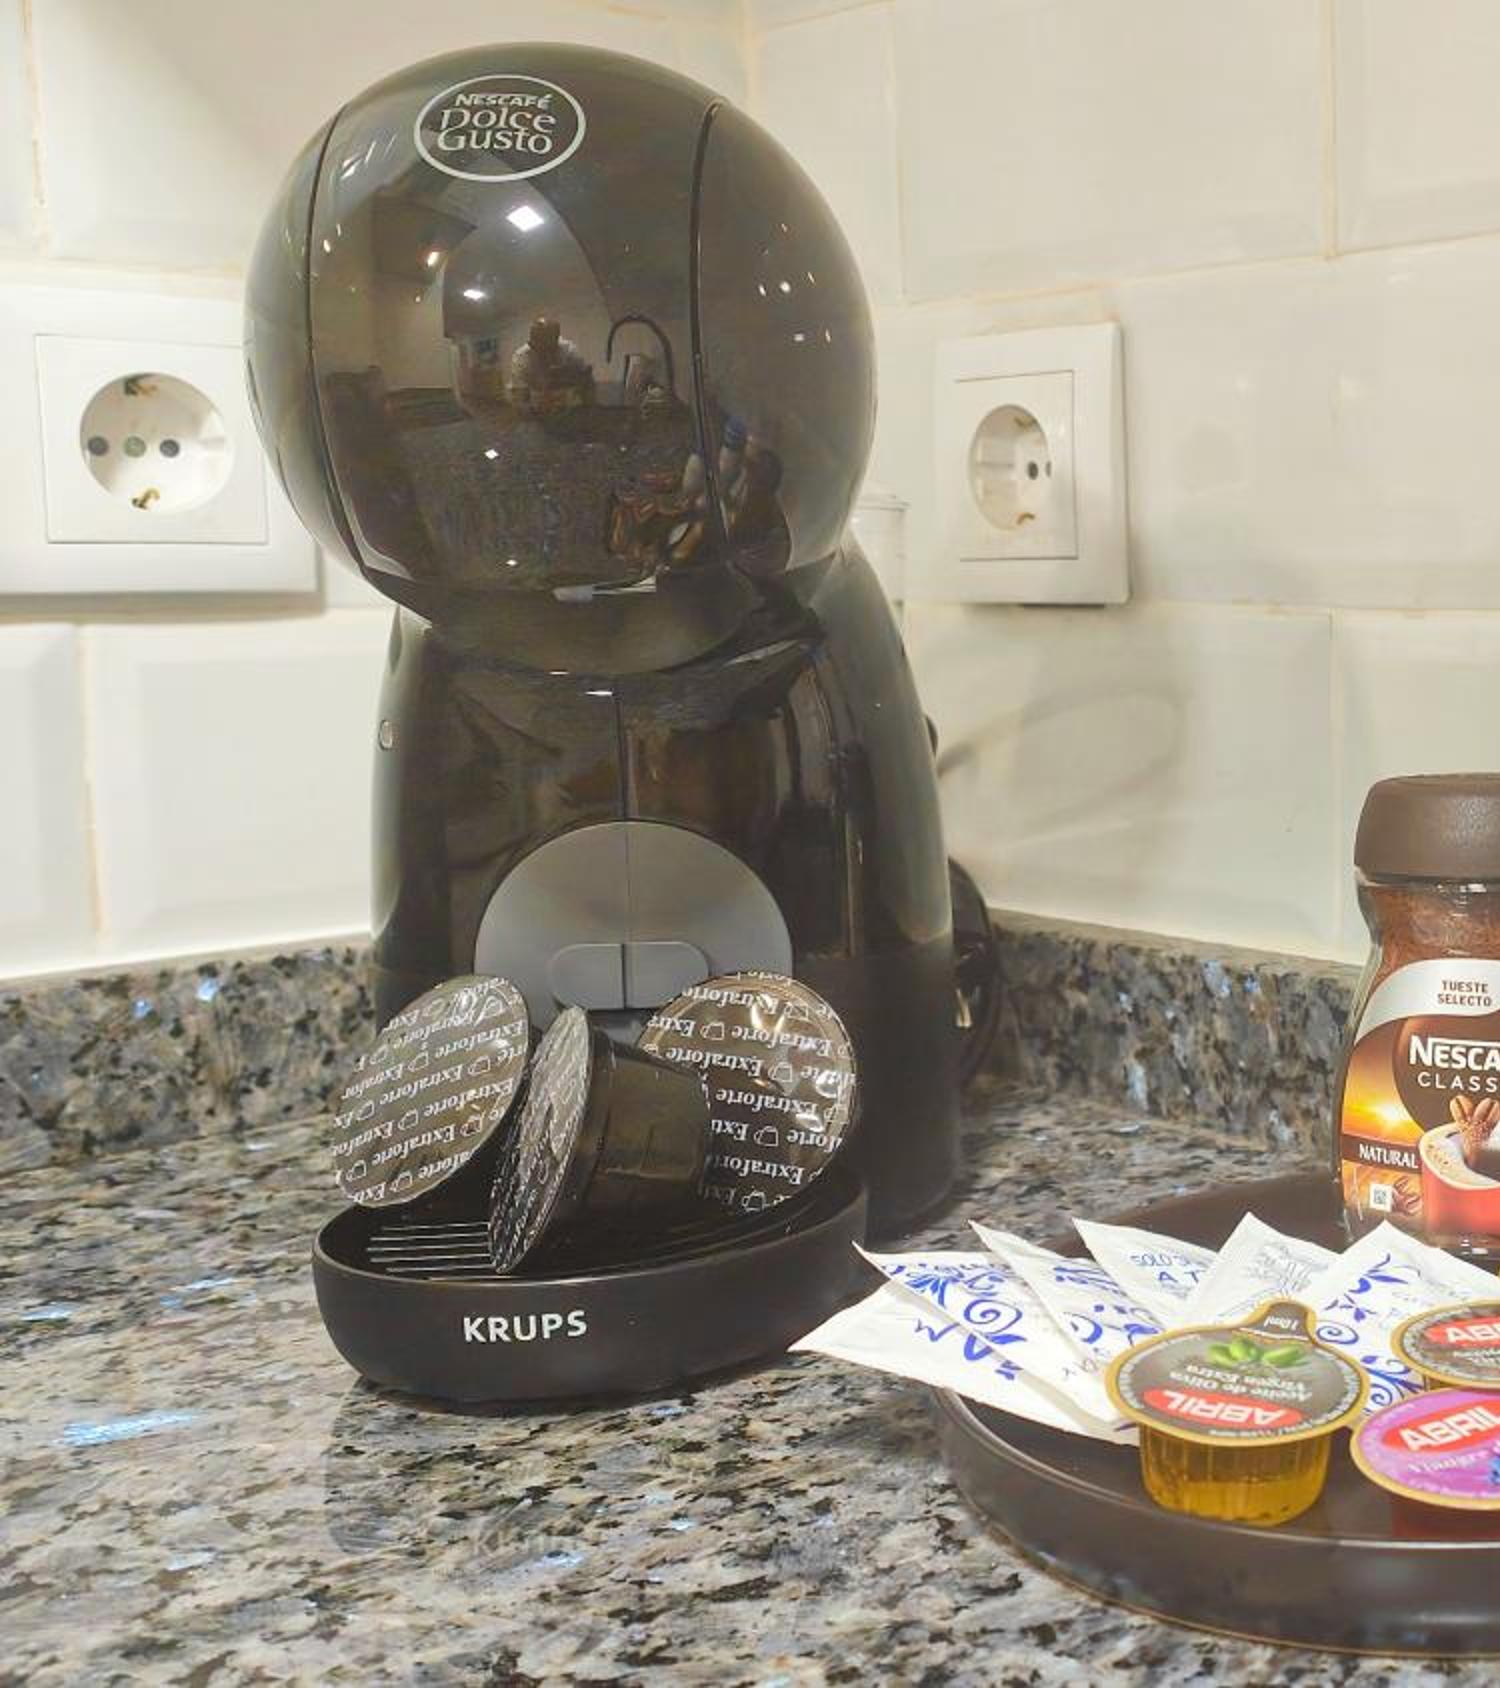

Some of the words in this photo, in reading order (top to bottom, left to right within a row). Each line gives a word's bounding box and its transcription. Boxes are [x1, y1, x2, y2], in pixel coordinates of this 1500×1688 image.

[455, 93, 553, 110] NESCAFÉ
[440, 107, 557, 133] Dolce
[437, 127, 554, 155] Gusto
[1437, 992, 1494, 1007] SELECTO
[1442, 979, 1490, 994] TUESTE
[731, 1024, 833, 1057] Extraforte
[664, 1046, 765, 1078] Extraforte
[715, 1088, 818, 1120] Extraforte
[1359, 1142, 1420, 1170] NATURAL
[463, 1309, 588, 1343] KRUPS
[1162, 1389, 1289, 1426] ABRIL
